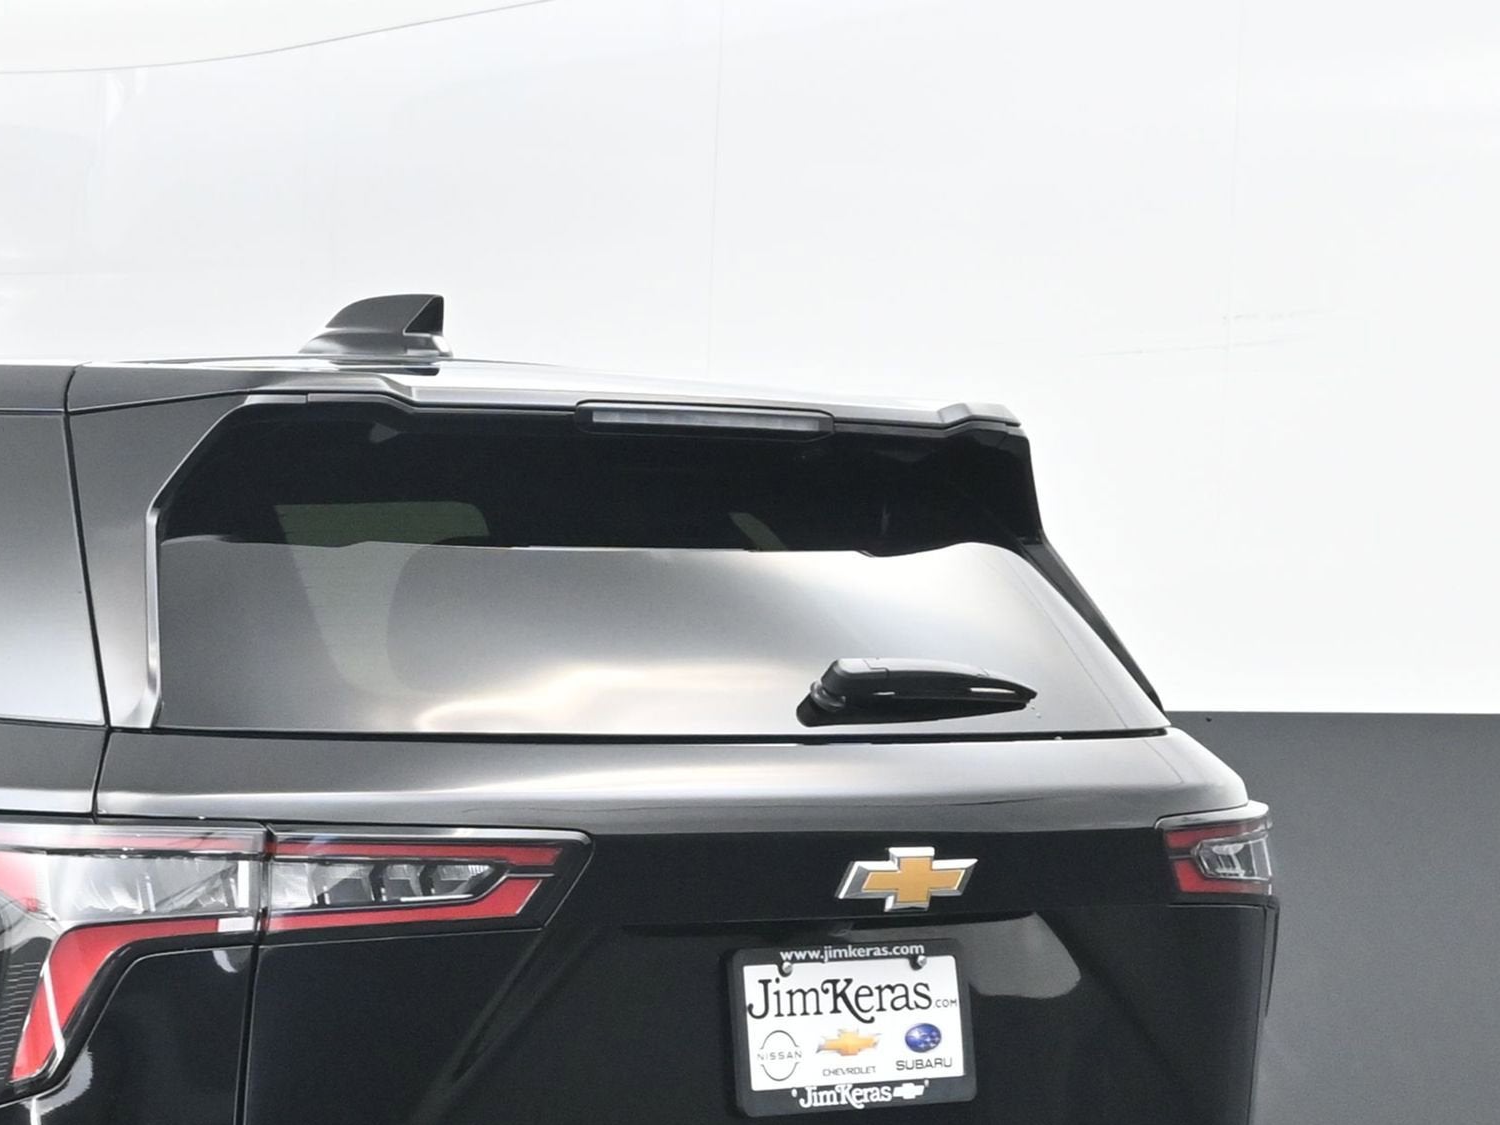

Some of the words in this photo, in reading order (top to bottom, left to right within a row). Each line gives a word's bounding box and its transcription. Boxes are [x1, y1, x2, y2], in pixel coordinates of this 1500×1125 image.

[780, 944, 925, 963] www.jimkeras.com
[757, 1050, 802, 1061] NISSAN
[822, 1065, 876, 1077] CHEVROLET
[896, 1057, 953, 1071] SUBARU
[799, 1084, 893, 1109] JimKeras
